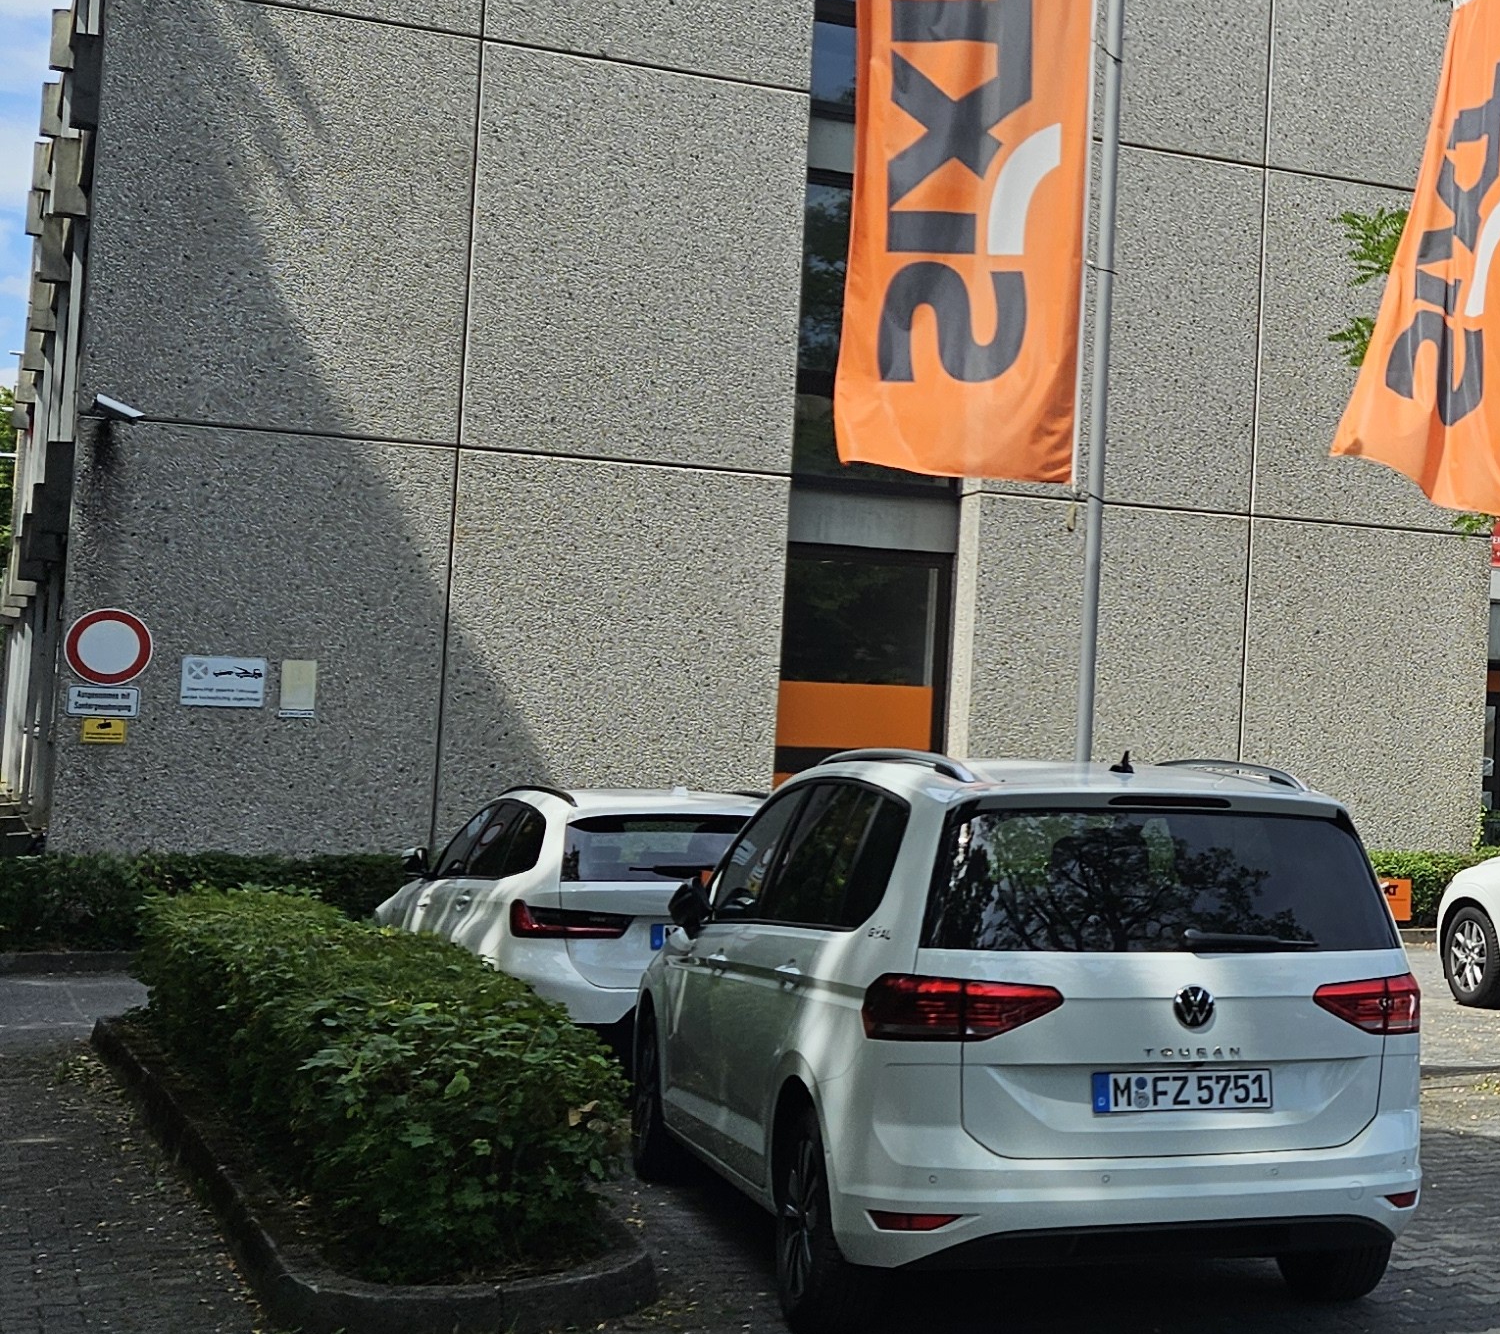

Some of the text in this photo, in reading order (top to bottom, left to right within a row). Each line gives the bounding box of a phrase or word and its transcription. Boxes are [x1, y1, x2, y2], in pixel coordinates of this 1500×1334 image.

[1142, 1046, 1241, 1058] TOURAN
[1113, 1077, 1132, 1107] M
[1152, 1076, 1190, 1106] FZ
[1197, 1074, 1268, 1105] 5751
